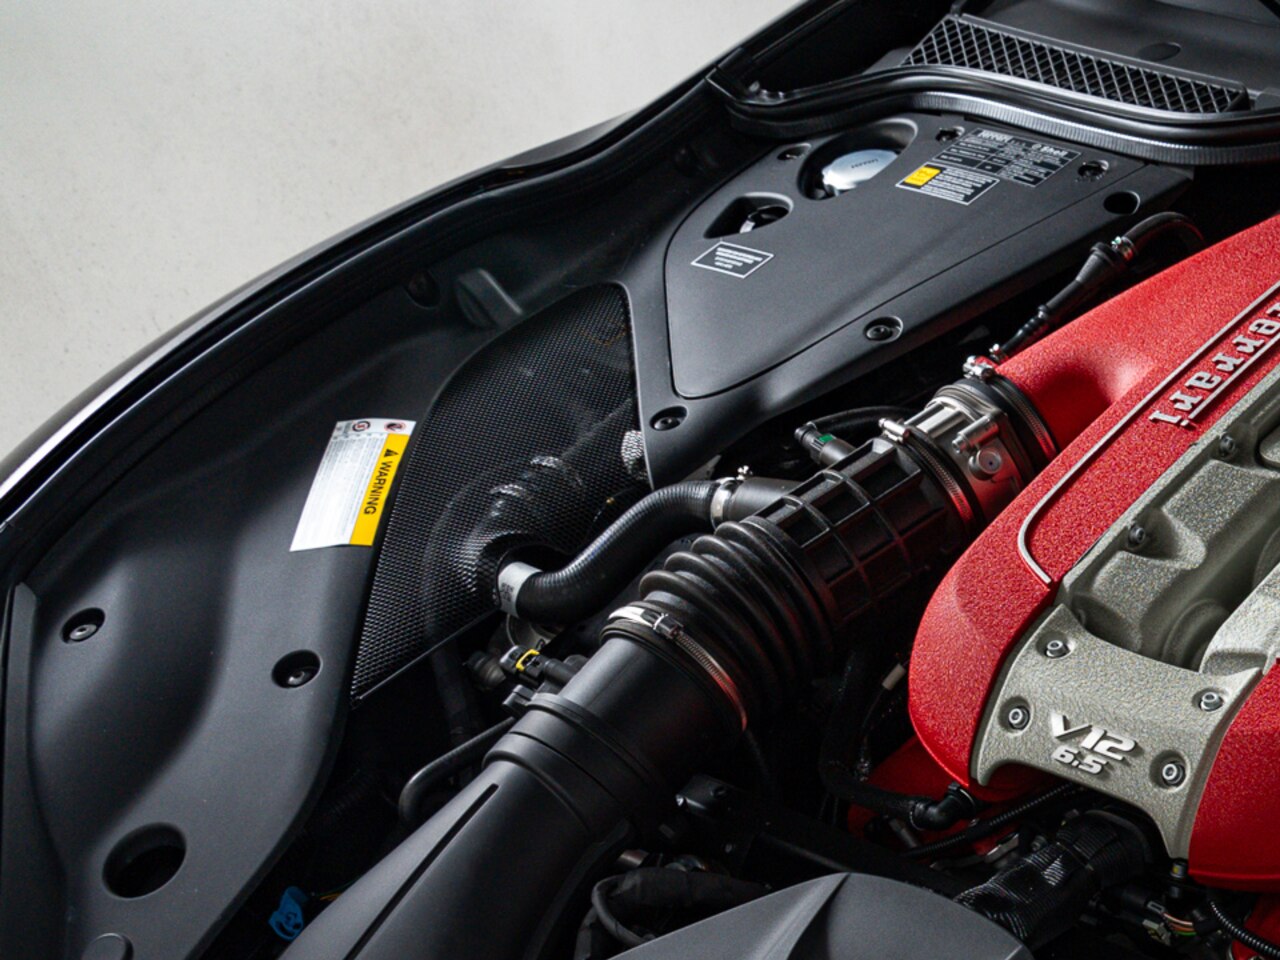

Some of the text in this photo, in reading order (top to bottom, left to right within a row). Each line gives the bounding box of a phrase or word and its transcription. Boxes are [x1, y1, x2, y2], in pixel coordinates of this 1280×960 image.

[363, 461, 393, 515] WARNING
[1051, 710, 1137, 761] V12
[1051, 746, 1108, 775] 6.5
